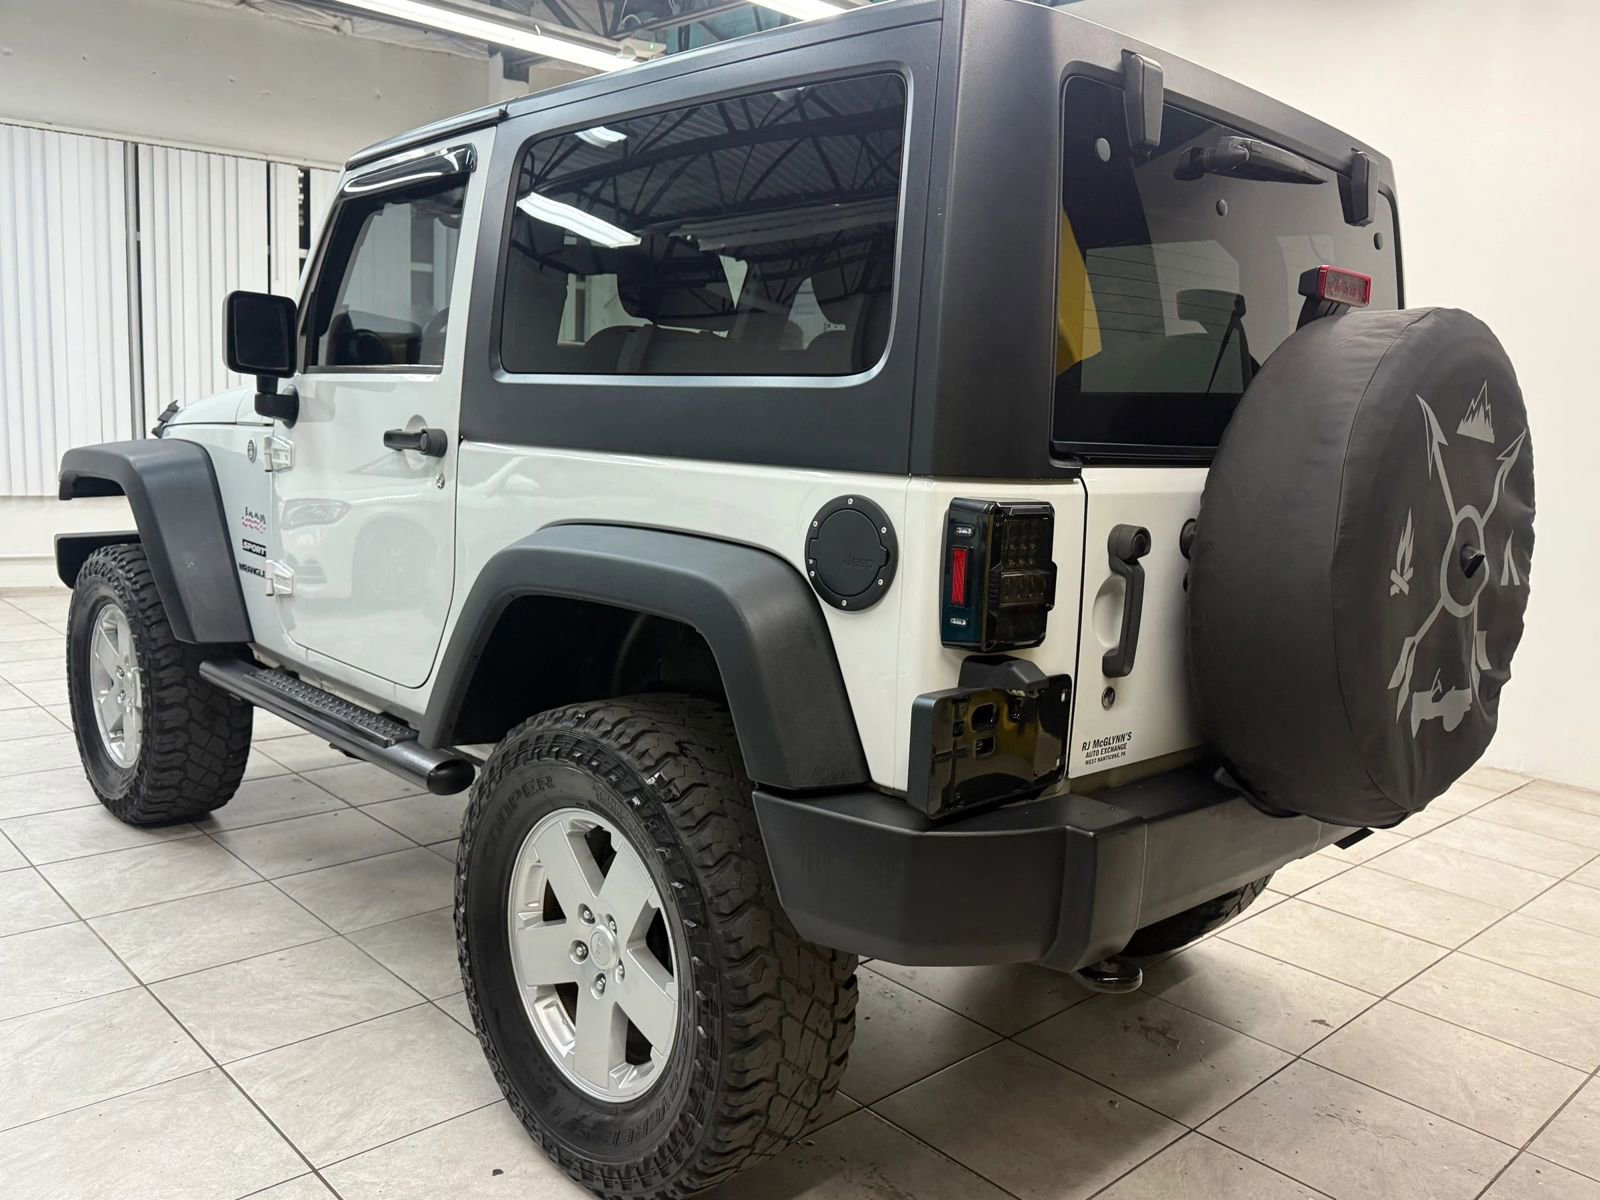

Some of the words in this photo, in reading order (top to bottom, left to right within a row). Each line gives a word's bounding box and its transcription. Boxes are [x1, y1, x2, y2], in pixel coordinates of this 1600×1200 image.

[243, 540, 266, 556] SPORT
[239, 562, 266, 578] WRANGLE
[1081, 741, 1091, 751] RJ
[1092, 731, 1132, 749] McGLYNN'S
[1085, 750, 1099, 758] AUTO
[1100, 742, 1127, 755] EXCHANGE
[480, 775, 555, 865] COOPER
